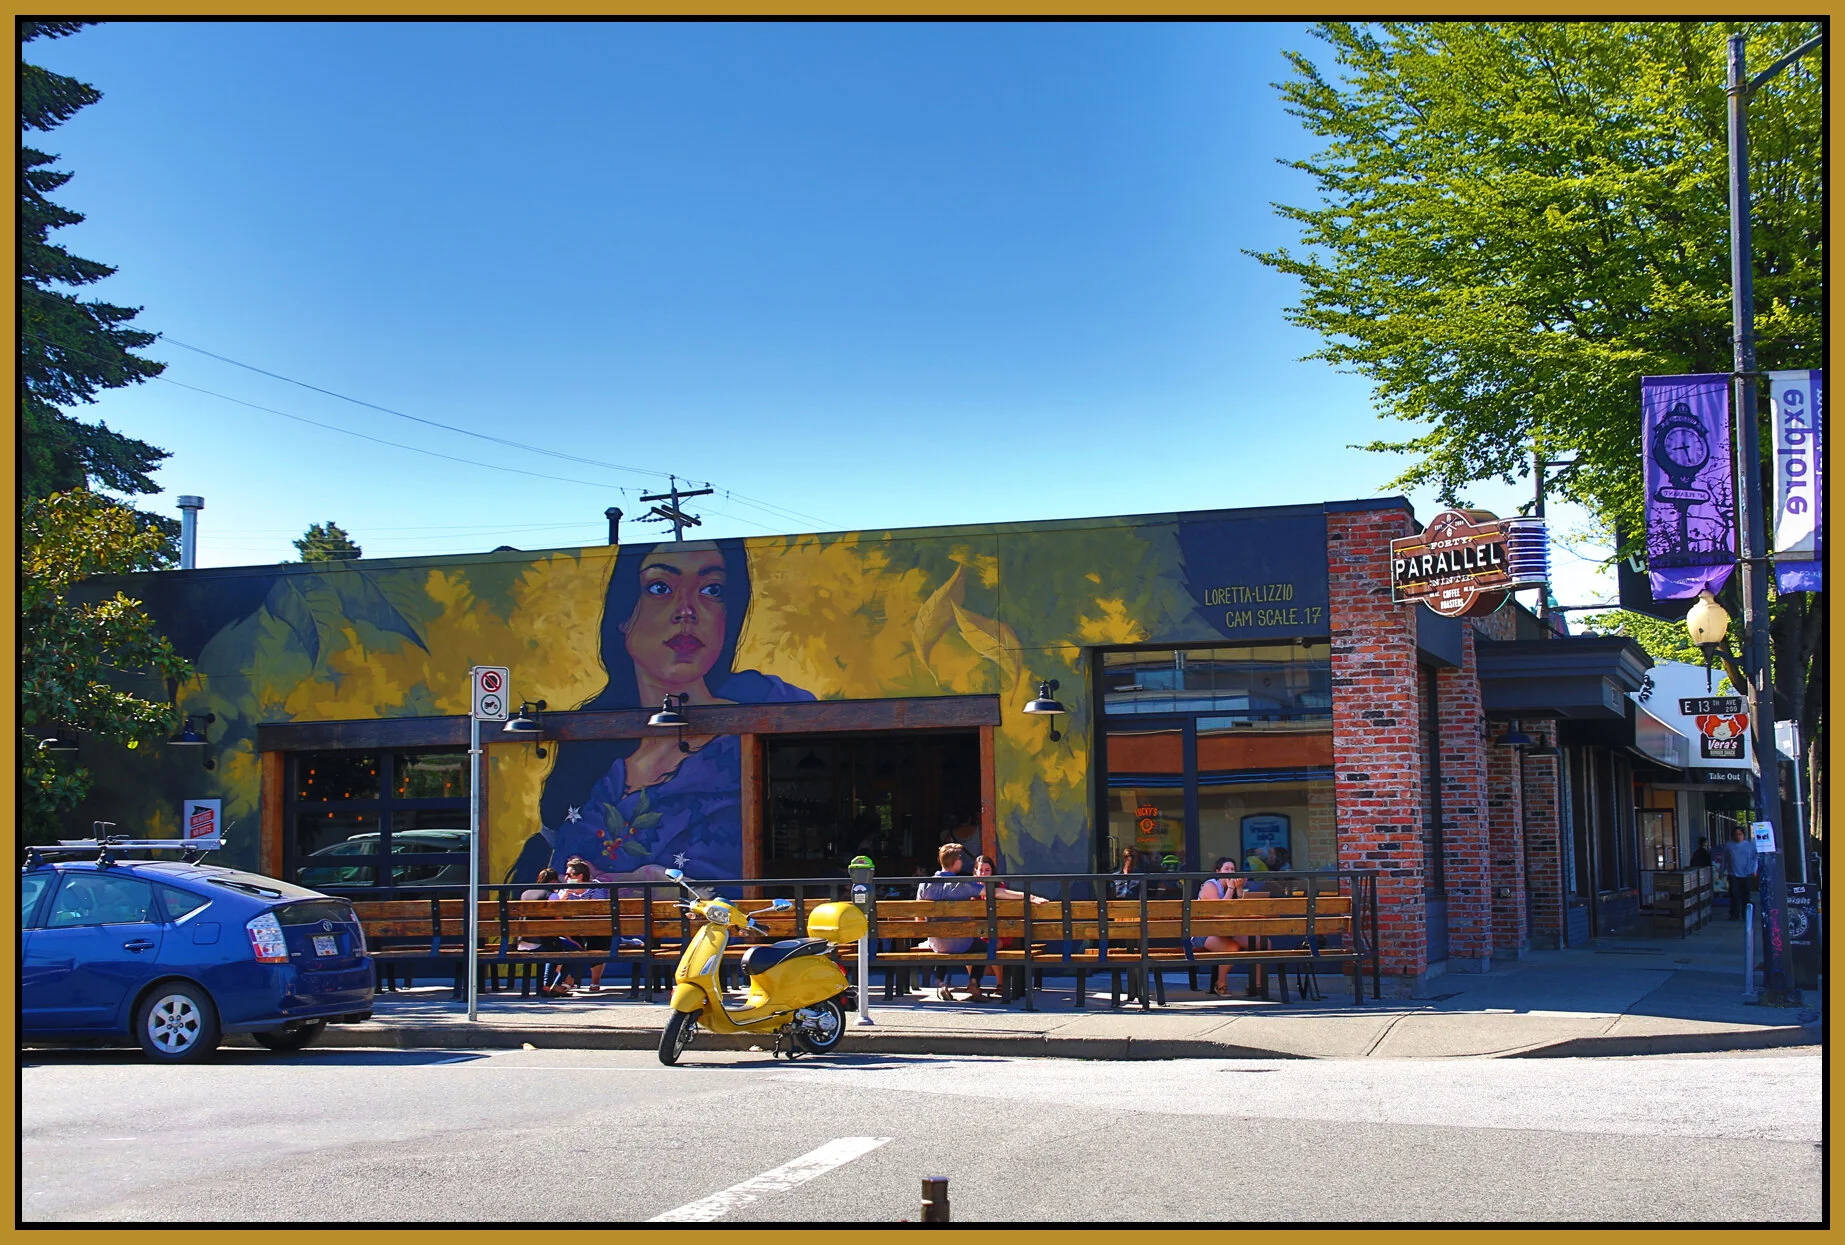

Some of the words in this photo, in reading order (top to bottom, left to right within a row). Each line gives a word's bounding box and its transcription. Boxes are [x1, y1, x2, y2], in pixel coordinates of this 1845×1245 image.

[1395, 543, 1501, 581] PARALLEL
[1443, 588, 1461, 599] COFFEE
[1226, 610, 1253, 628] CAM
[1684, 701, 1692, 713] E
[1707, 739, 1738, 751] Vera's
[1709, 772, 1726, 780] Take
[1727, 772, 1741, 780] Out
